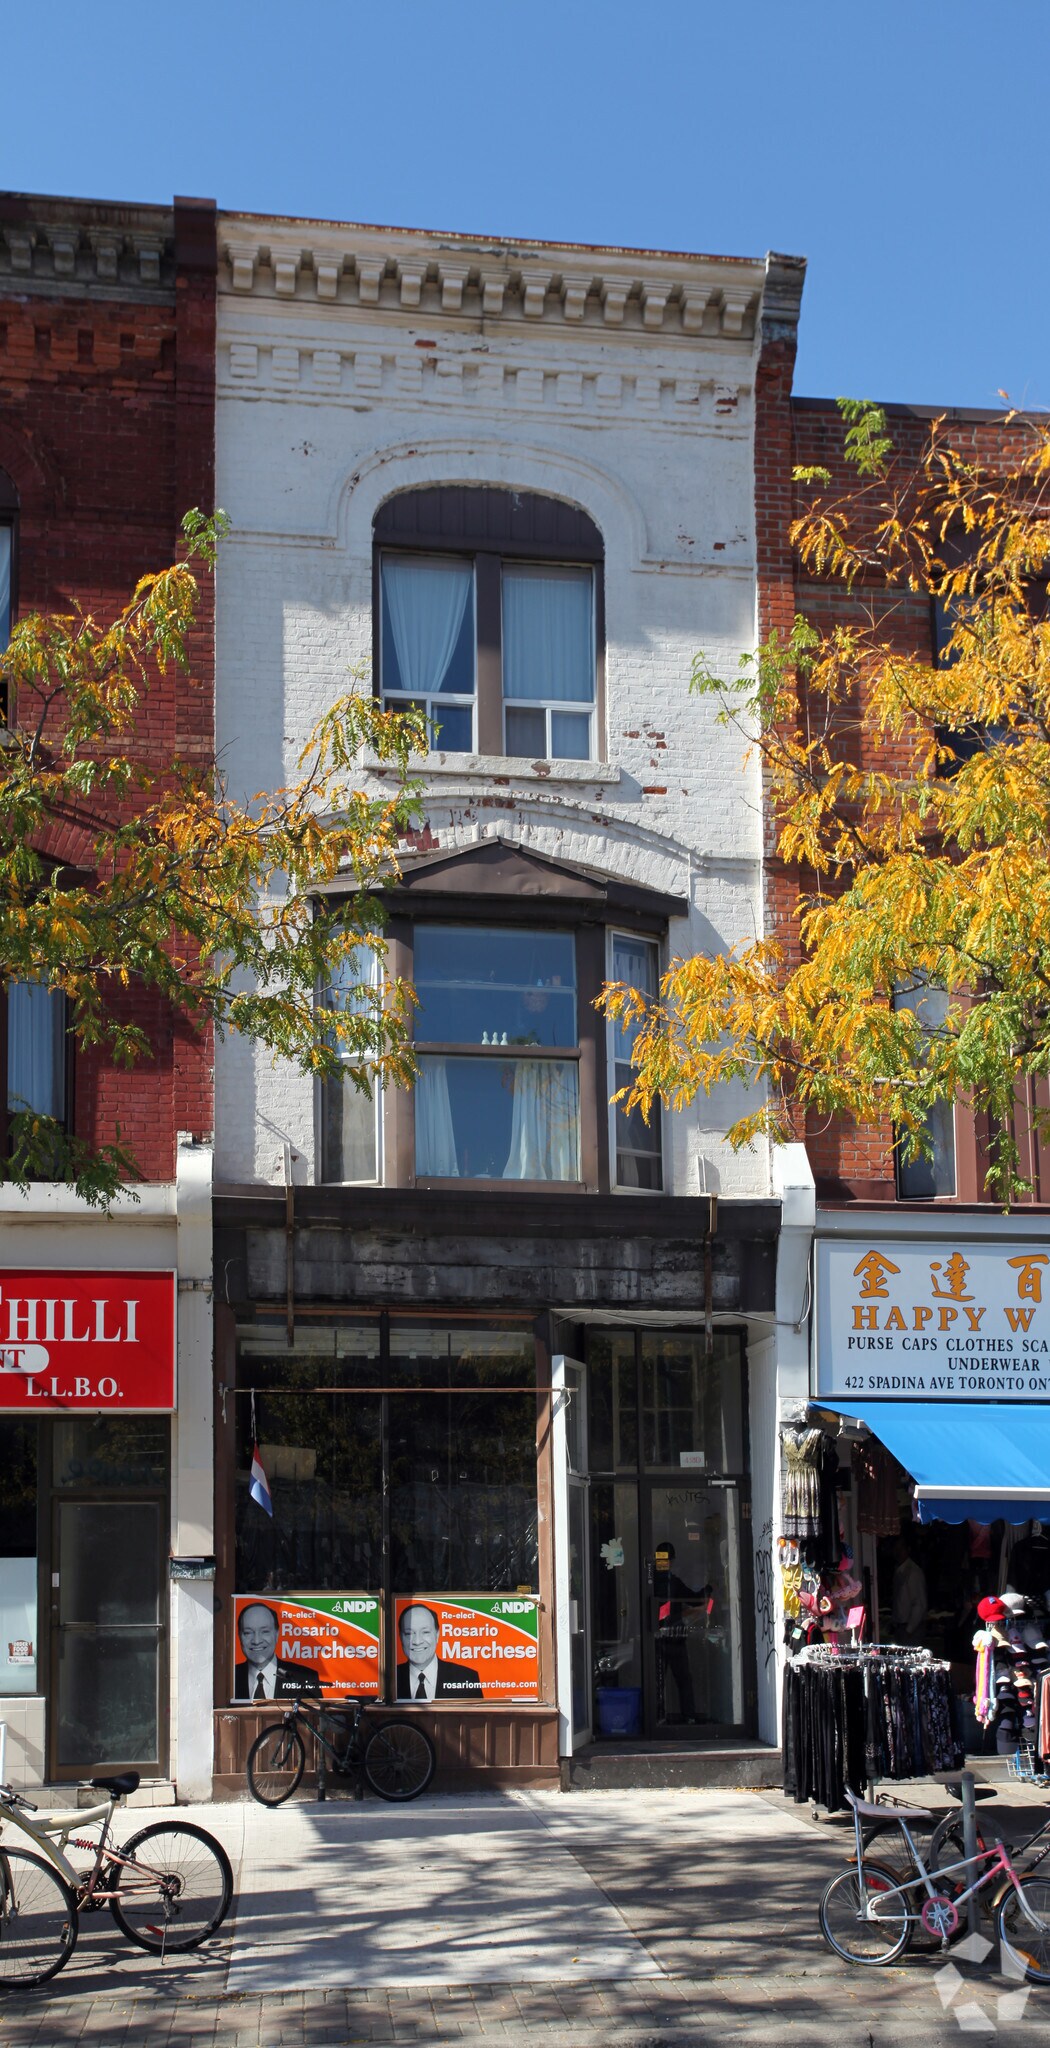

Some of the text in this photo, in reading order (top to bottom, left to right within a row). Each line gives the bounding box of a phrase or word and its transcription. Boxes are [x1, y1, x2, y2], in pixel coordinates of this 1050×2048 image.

[0, 1286, 141, 1343] HILLI
[852, 1306, 1036, 1333] HAPPY W
[848, 1337, 1049, 1353] PURSE CAPS CLOTHES SCA
[948, 1357, 1040, 1371] UNDERWEAR
[25, 1377, 124, 1398] L.L.B.O.
[845, 1376, 864, 1389] 422
[868, 1376, 925, 1390] SPADINA
[930, 1377, 954, 1390] AVE
[959, 1377, 1025, 1391] TORONTO
[344, 1601, 378, 1612] NDP
[502, 1602, 535, 1613] NDP
[281, 1611, 316, 1619] Re-elect
[441, 1611, 476, 1619] Re-elect
[281, 1623, 339, 1637] Rosario
[441, 1624, 499, 1637] Rosario
[281, 1640, 378, 1659] Marchese
[441, 1641, 537, 1660] Marchese
[443, 1680, 538, 1690] rosariomarchese.com
